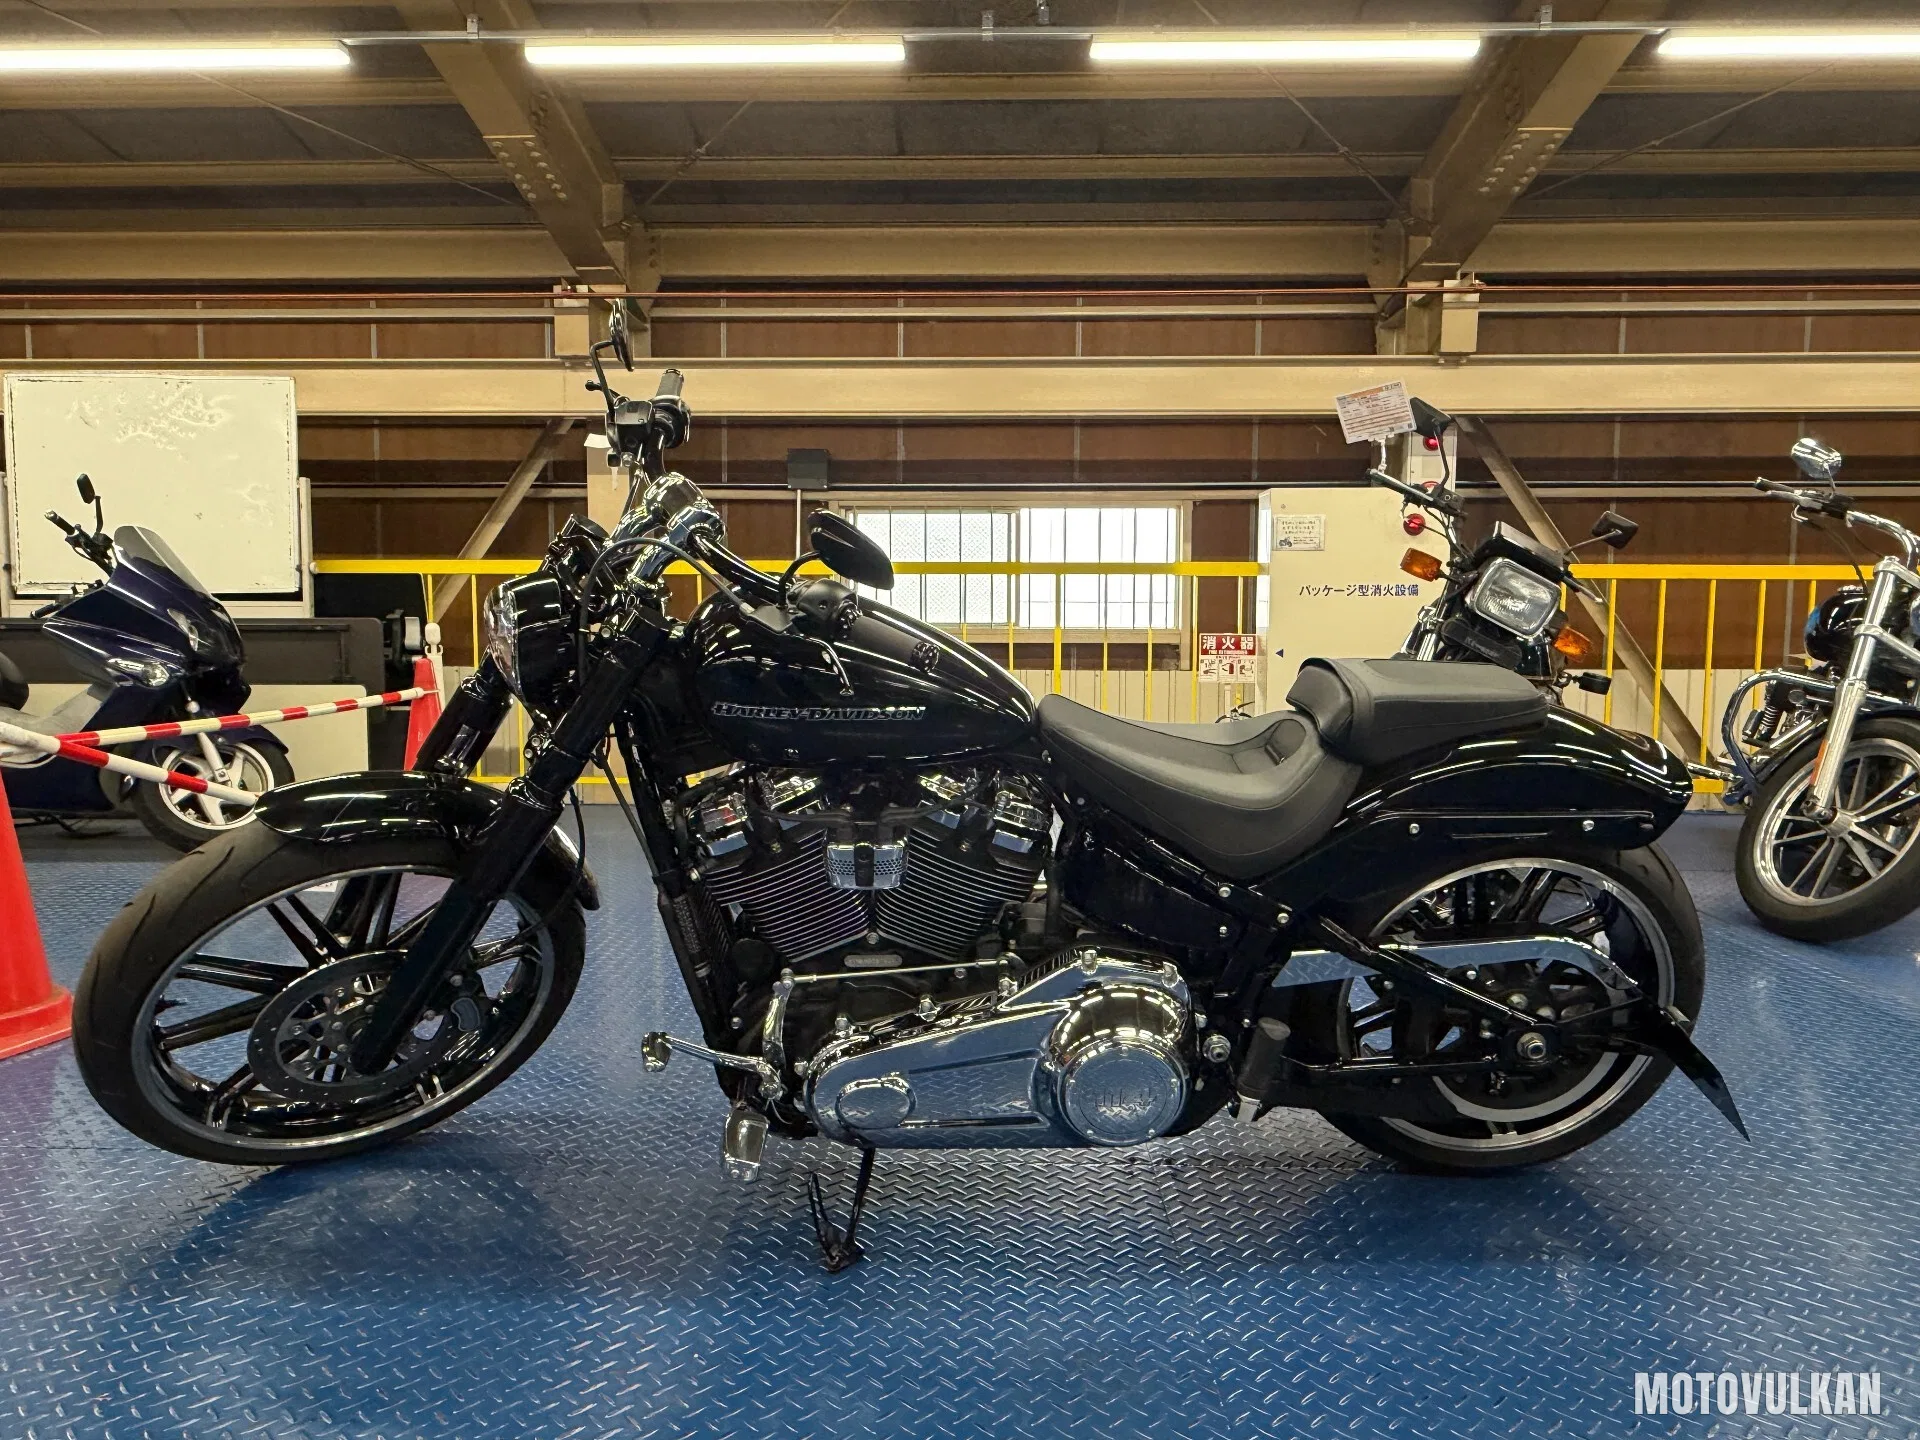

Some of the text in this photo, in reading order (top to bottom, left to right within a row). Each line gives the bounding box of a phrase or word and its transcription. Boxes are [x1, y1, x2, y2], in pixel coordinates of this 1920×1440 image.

[1299, 584, 1419, 597] パッケージ型消火設備
[1202, 635, 1254, 650] 消火器
[711, 702, 926, 721] HARLEY-DAVIDSON
